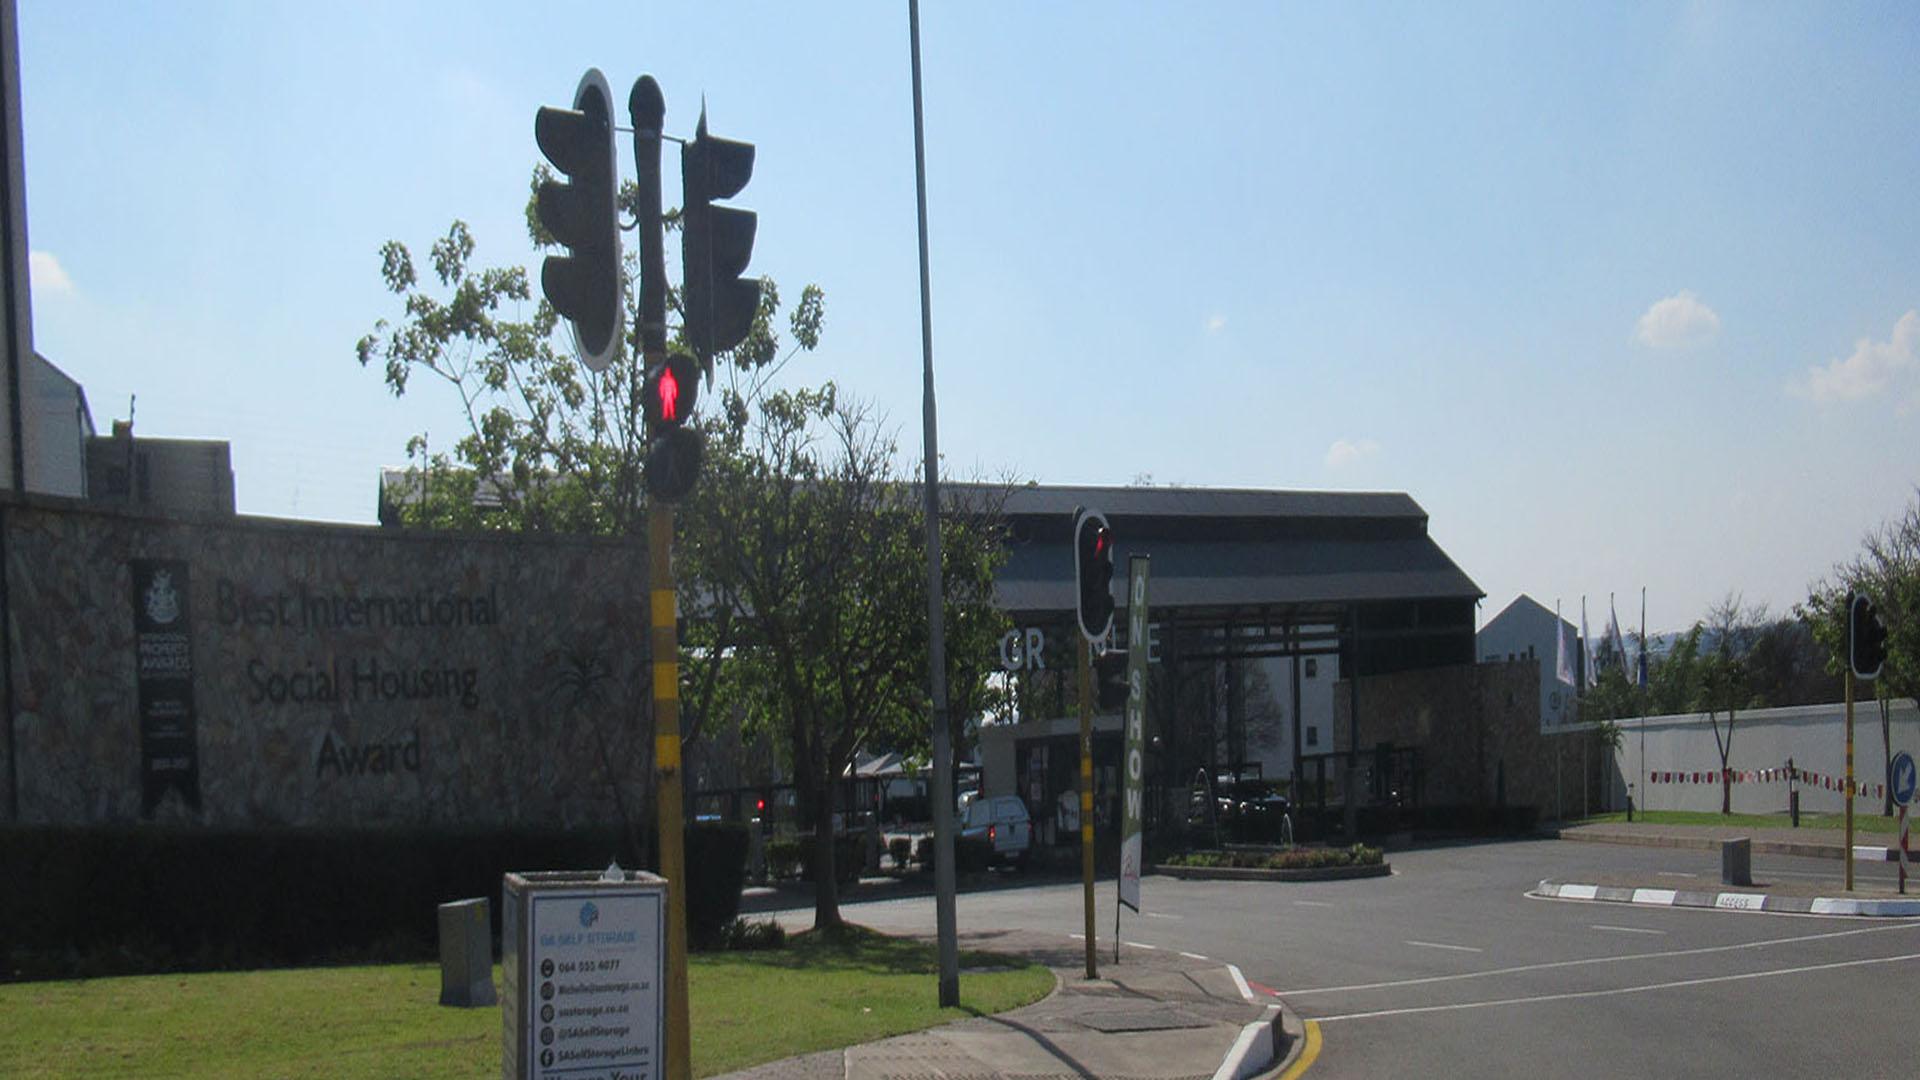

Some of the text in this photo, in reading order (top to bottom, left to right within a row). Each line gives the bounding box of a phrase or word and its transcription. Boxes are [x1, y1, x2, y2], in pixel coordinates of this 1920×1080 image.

[217, 579, 496, 626] Best International
[247, 656, 479, 710] Social Housing
[316, 725, 421, 777] Award
[1126, 669, 1143, 819] SHOW
